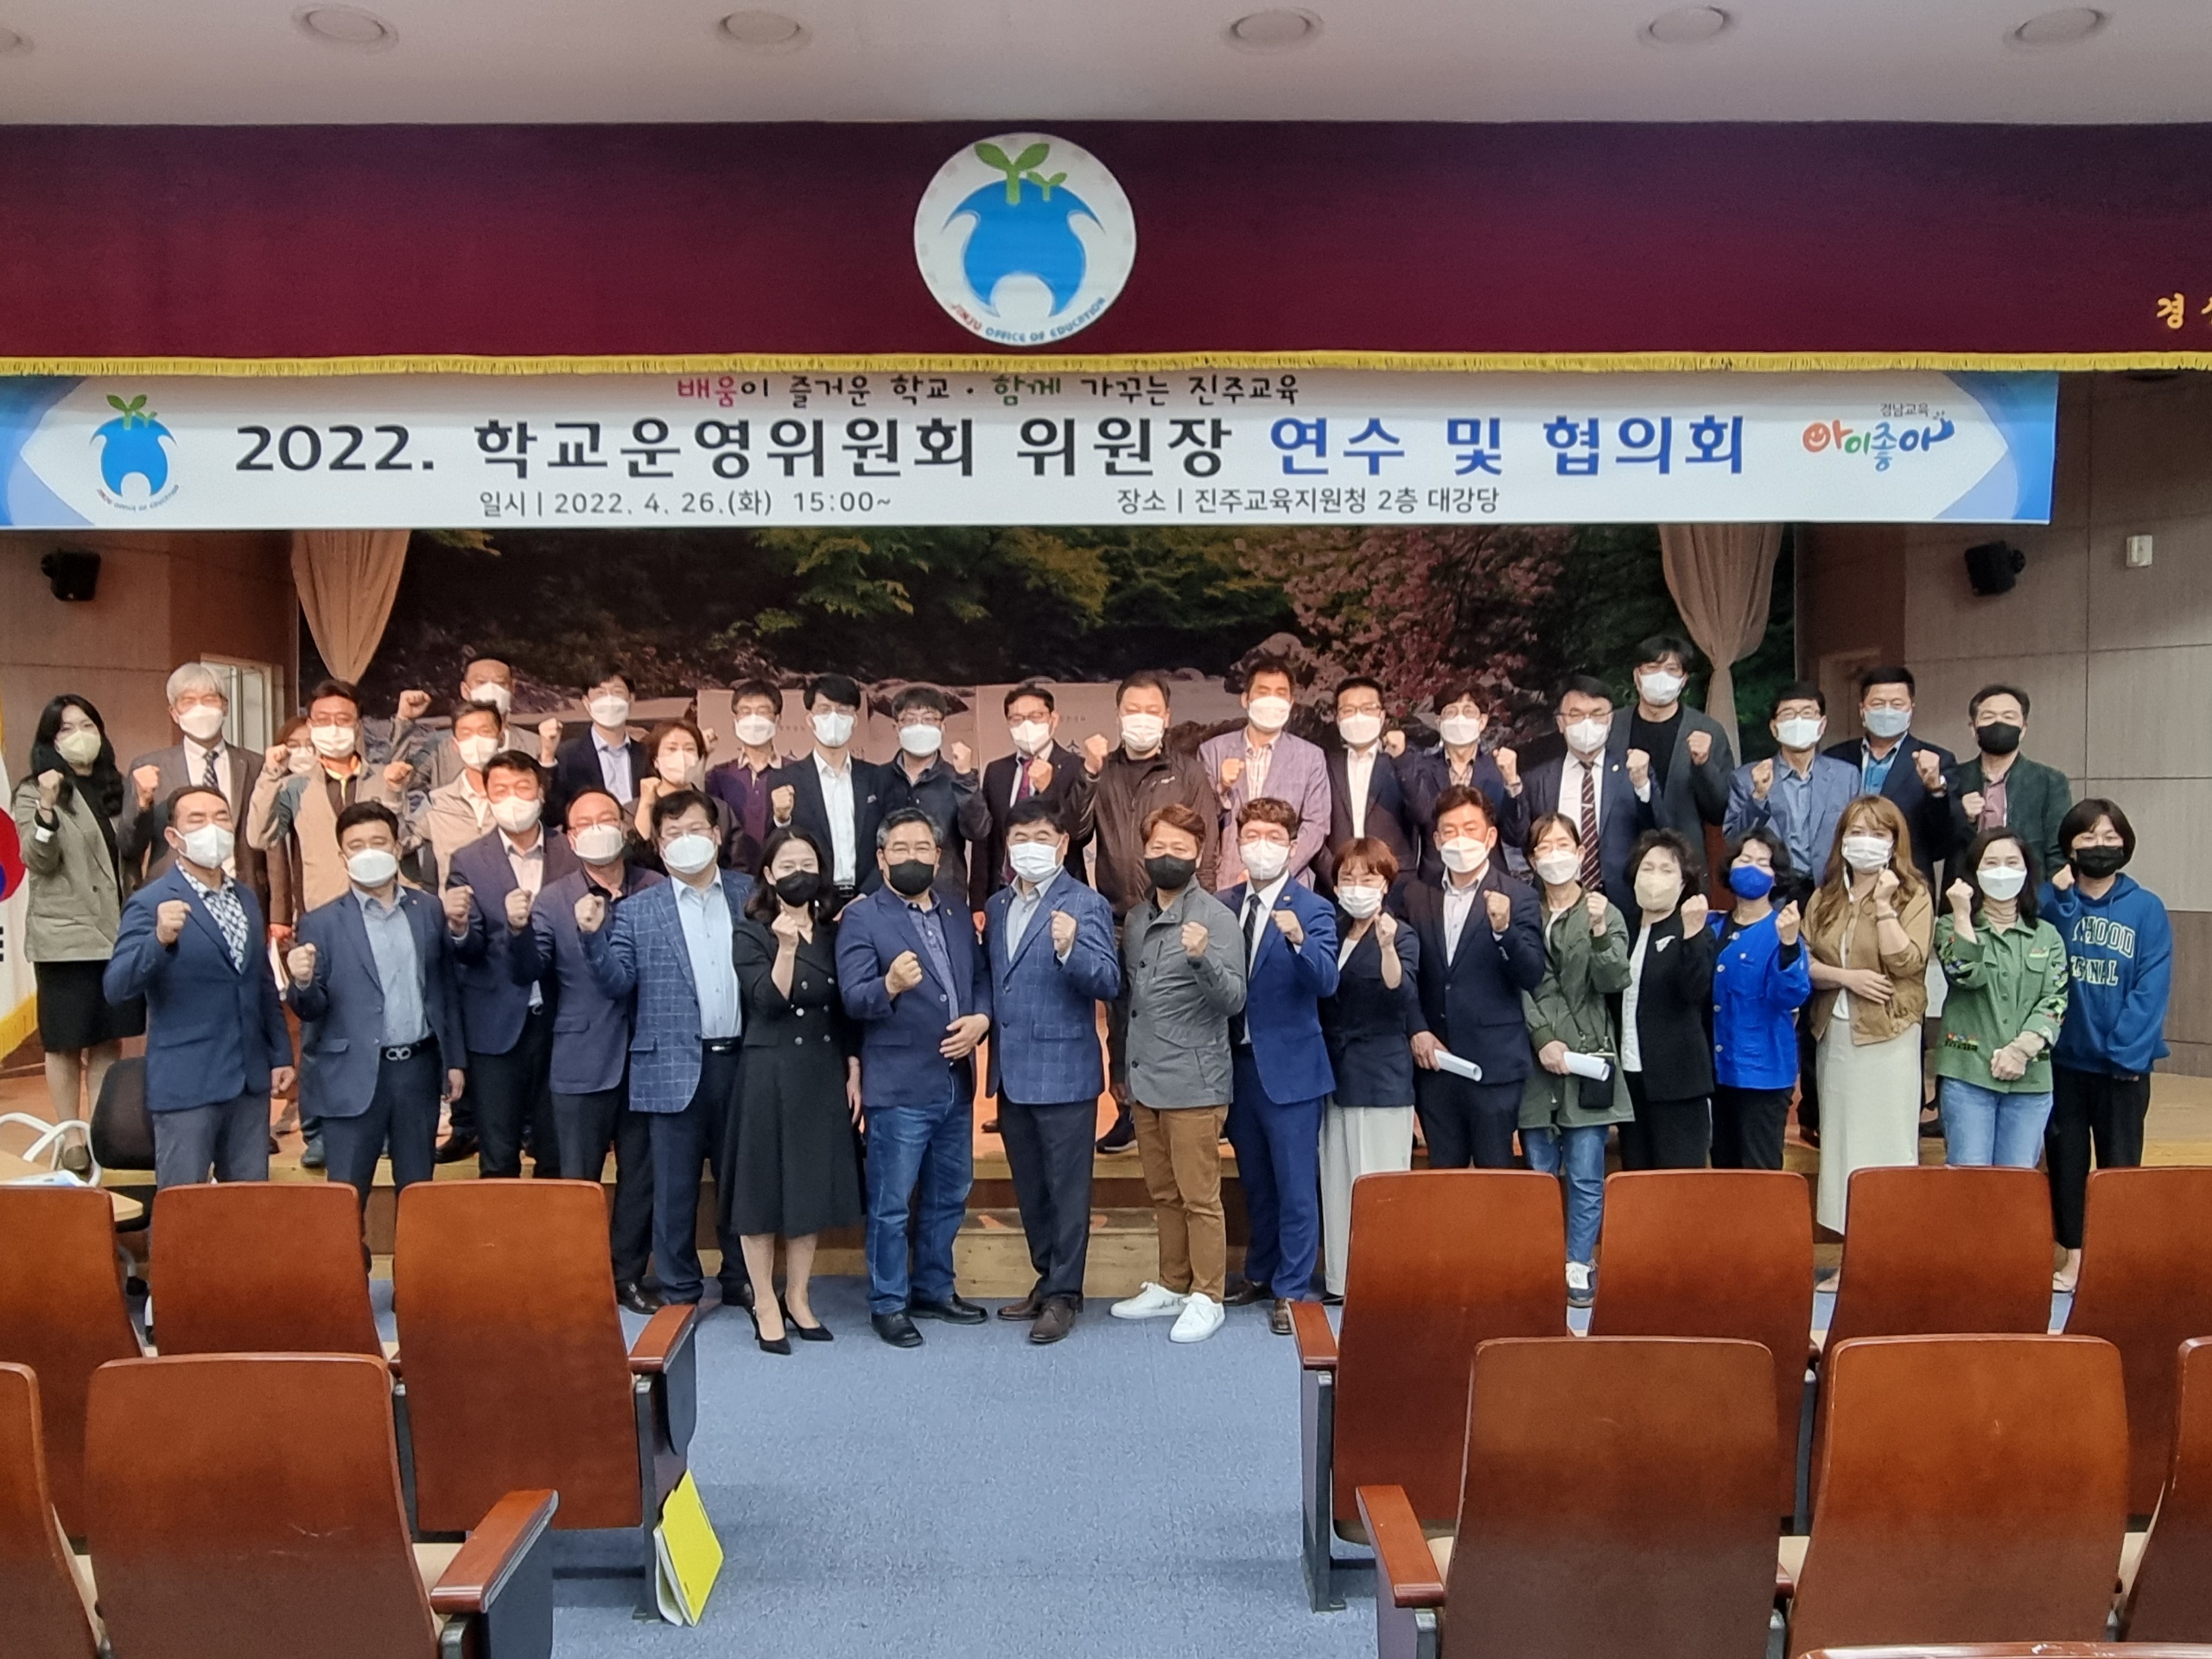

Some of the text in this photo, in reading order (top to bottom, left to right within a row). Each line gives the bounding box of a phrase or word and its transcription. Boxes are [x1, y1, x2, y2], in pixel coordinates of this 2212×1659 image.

[985, 327, 1027, 342] OFFICE
[1030, 329, 1046, 341] OF
[1049, 296, 1106, 338] EDUCATION
[677, 375, 769, 408] 배움이
[789, 375, 871, 410] 즐거운
[890, 374, 950, 406] 학교
[992, 374, 1061, 406] 함께
[1080, 375, 1170, 406] 가꾸는
[1188, 373, 1299, 406] 진주교육
[1878, 402, 1929, 417] 경남교육
[235, 414, 1745, 480] 2022. 학교운영위원회 위원장 연수 및 협의회
[1802, 417, 1955, 472] 아이좋아
[480, 490, 525, 518] 일시
[554, 492, 632, 515] 2022.
[644, 492, 669, 515] 4.
[681, 488, 772, 517] 26.(화)
[793, 490, 892, 513] 15:00~
[1116, 487, 1166, 515] 장소
[1194, 486, 1366, 515] 진주교육지원청
[1377, 486, 1419, 514] 2층
[1427, 486, 1500, 514] 대강당
